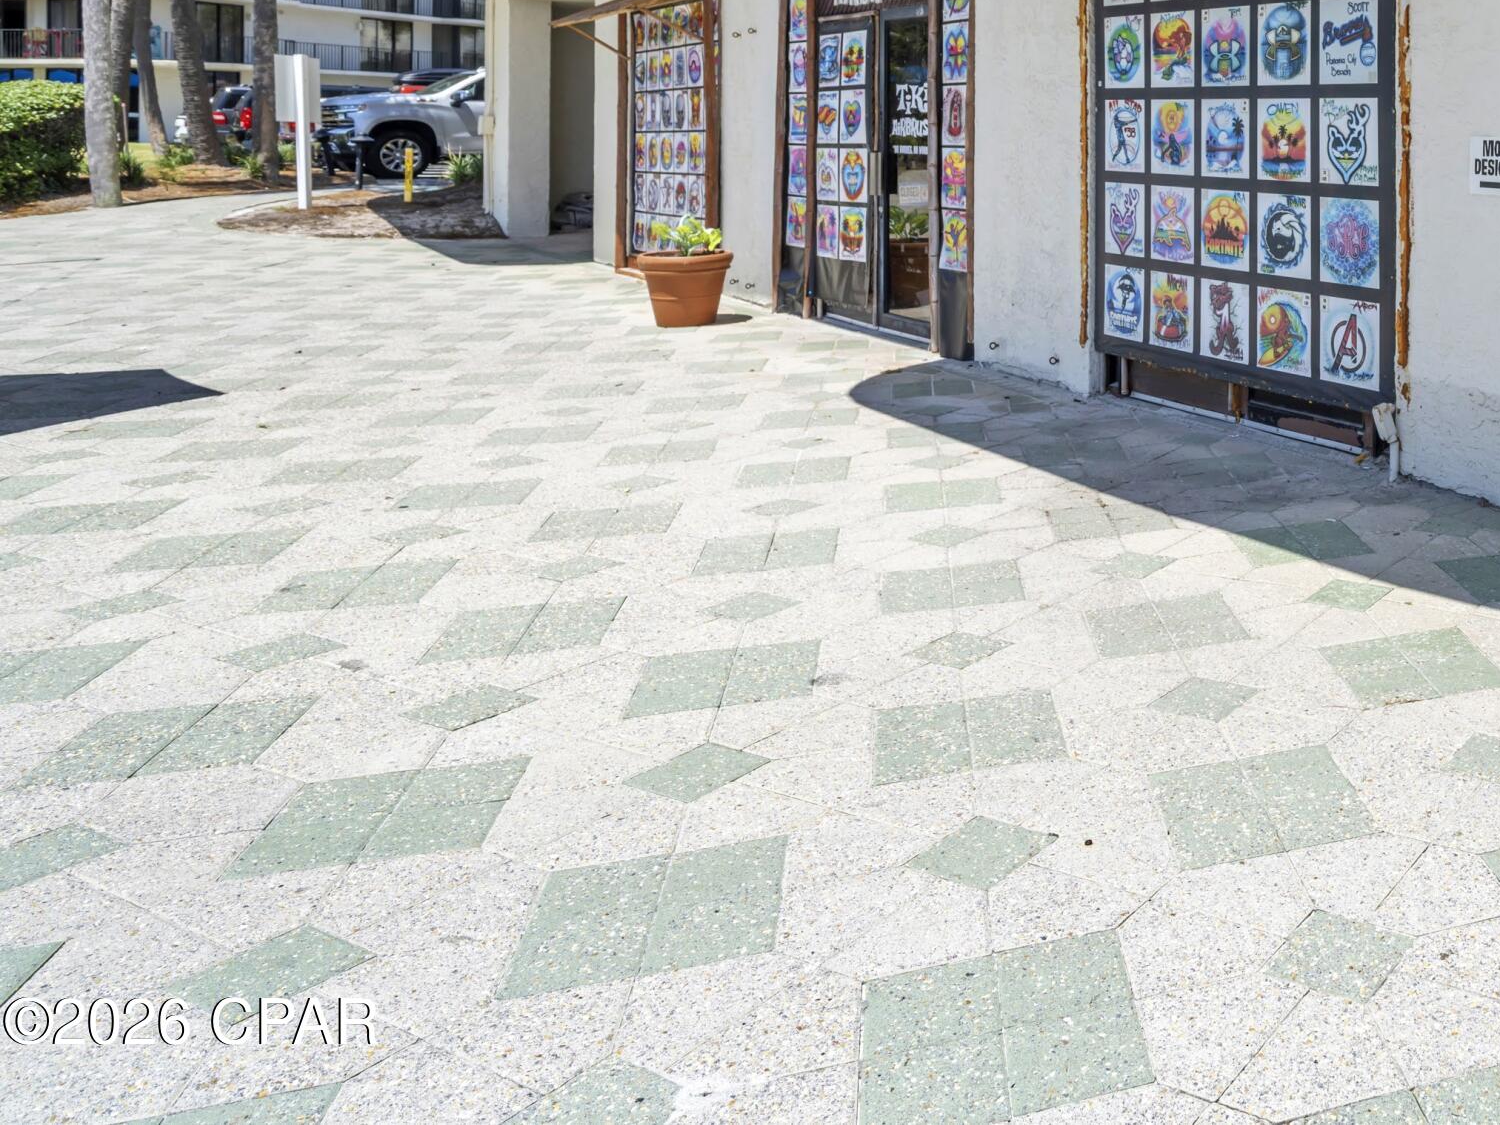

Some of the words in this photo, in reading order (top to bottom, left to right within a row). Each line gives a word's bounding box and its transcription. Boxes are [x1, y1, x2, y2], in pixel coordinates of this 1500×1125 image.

[1347, 1, 1370, 14] SCOTT
[1266, 102, 1299, 116] OWEN
[891, 117, 928, 137] AiRBRUS
[1206, 237, 1244, 258] FORTNITE
